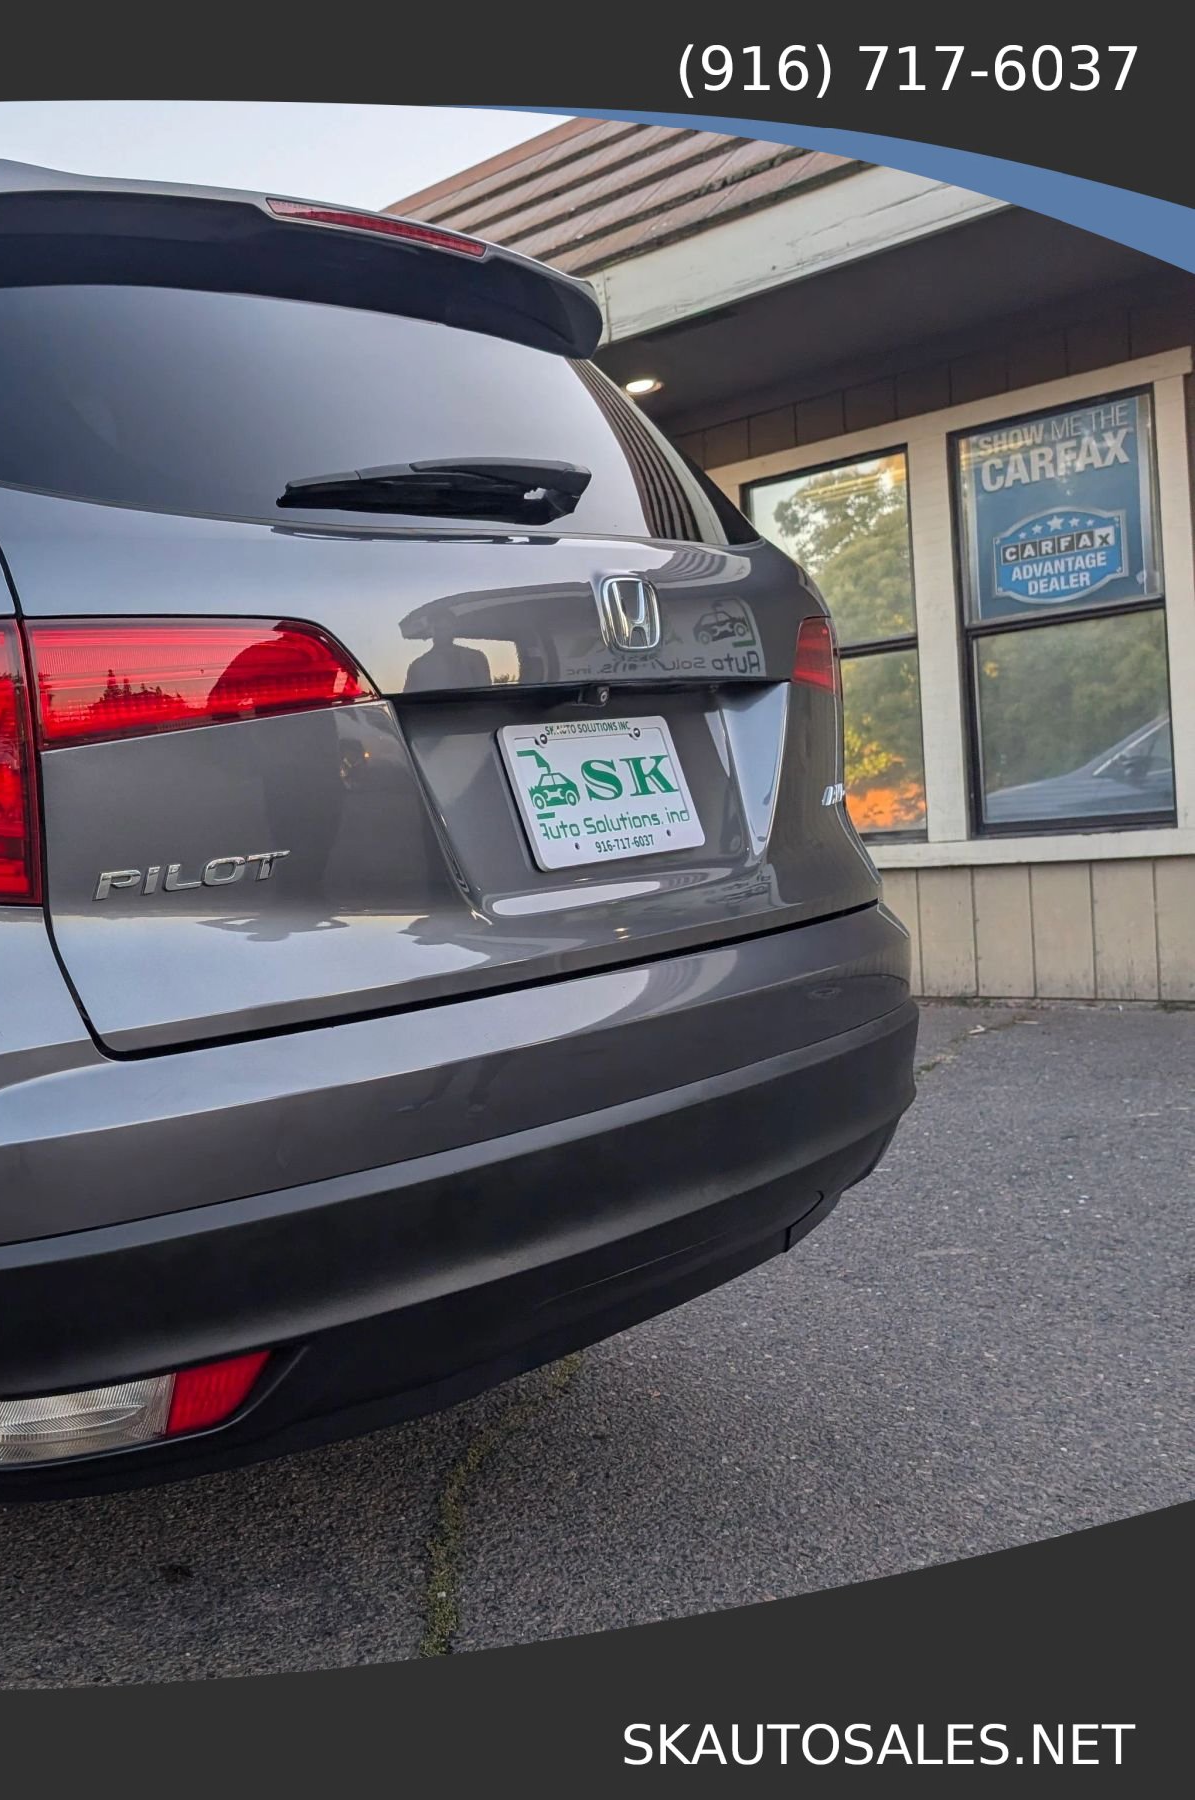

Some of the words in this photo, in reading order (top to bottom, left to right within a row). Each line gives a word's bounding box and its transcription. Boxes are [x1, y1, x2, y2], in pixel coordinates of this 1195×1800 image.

[980, 425, 1045, 455] SHOW
[1051, 415, 1085, 441] ME
[1090, 403, 1128, 432] THE
[981, 429, 1130, 492] CARFAX
[1005, 532, 1112, 561] CARFAX
[1012, 551, 1107, 581] ADVANTAGE
[1028, 572, 1091, 596] DEALER
[578, 721, 618, 733] SOLUTIONS
[618, 720, 631, 730] INC
[580, 754, 680, 801] SK
[595, 834, 655, 853] 916-717-6037
[93, 850, 291, 901] PILOT
